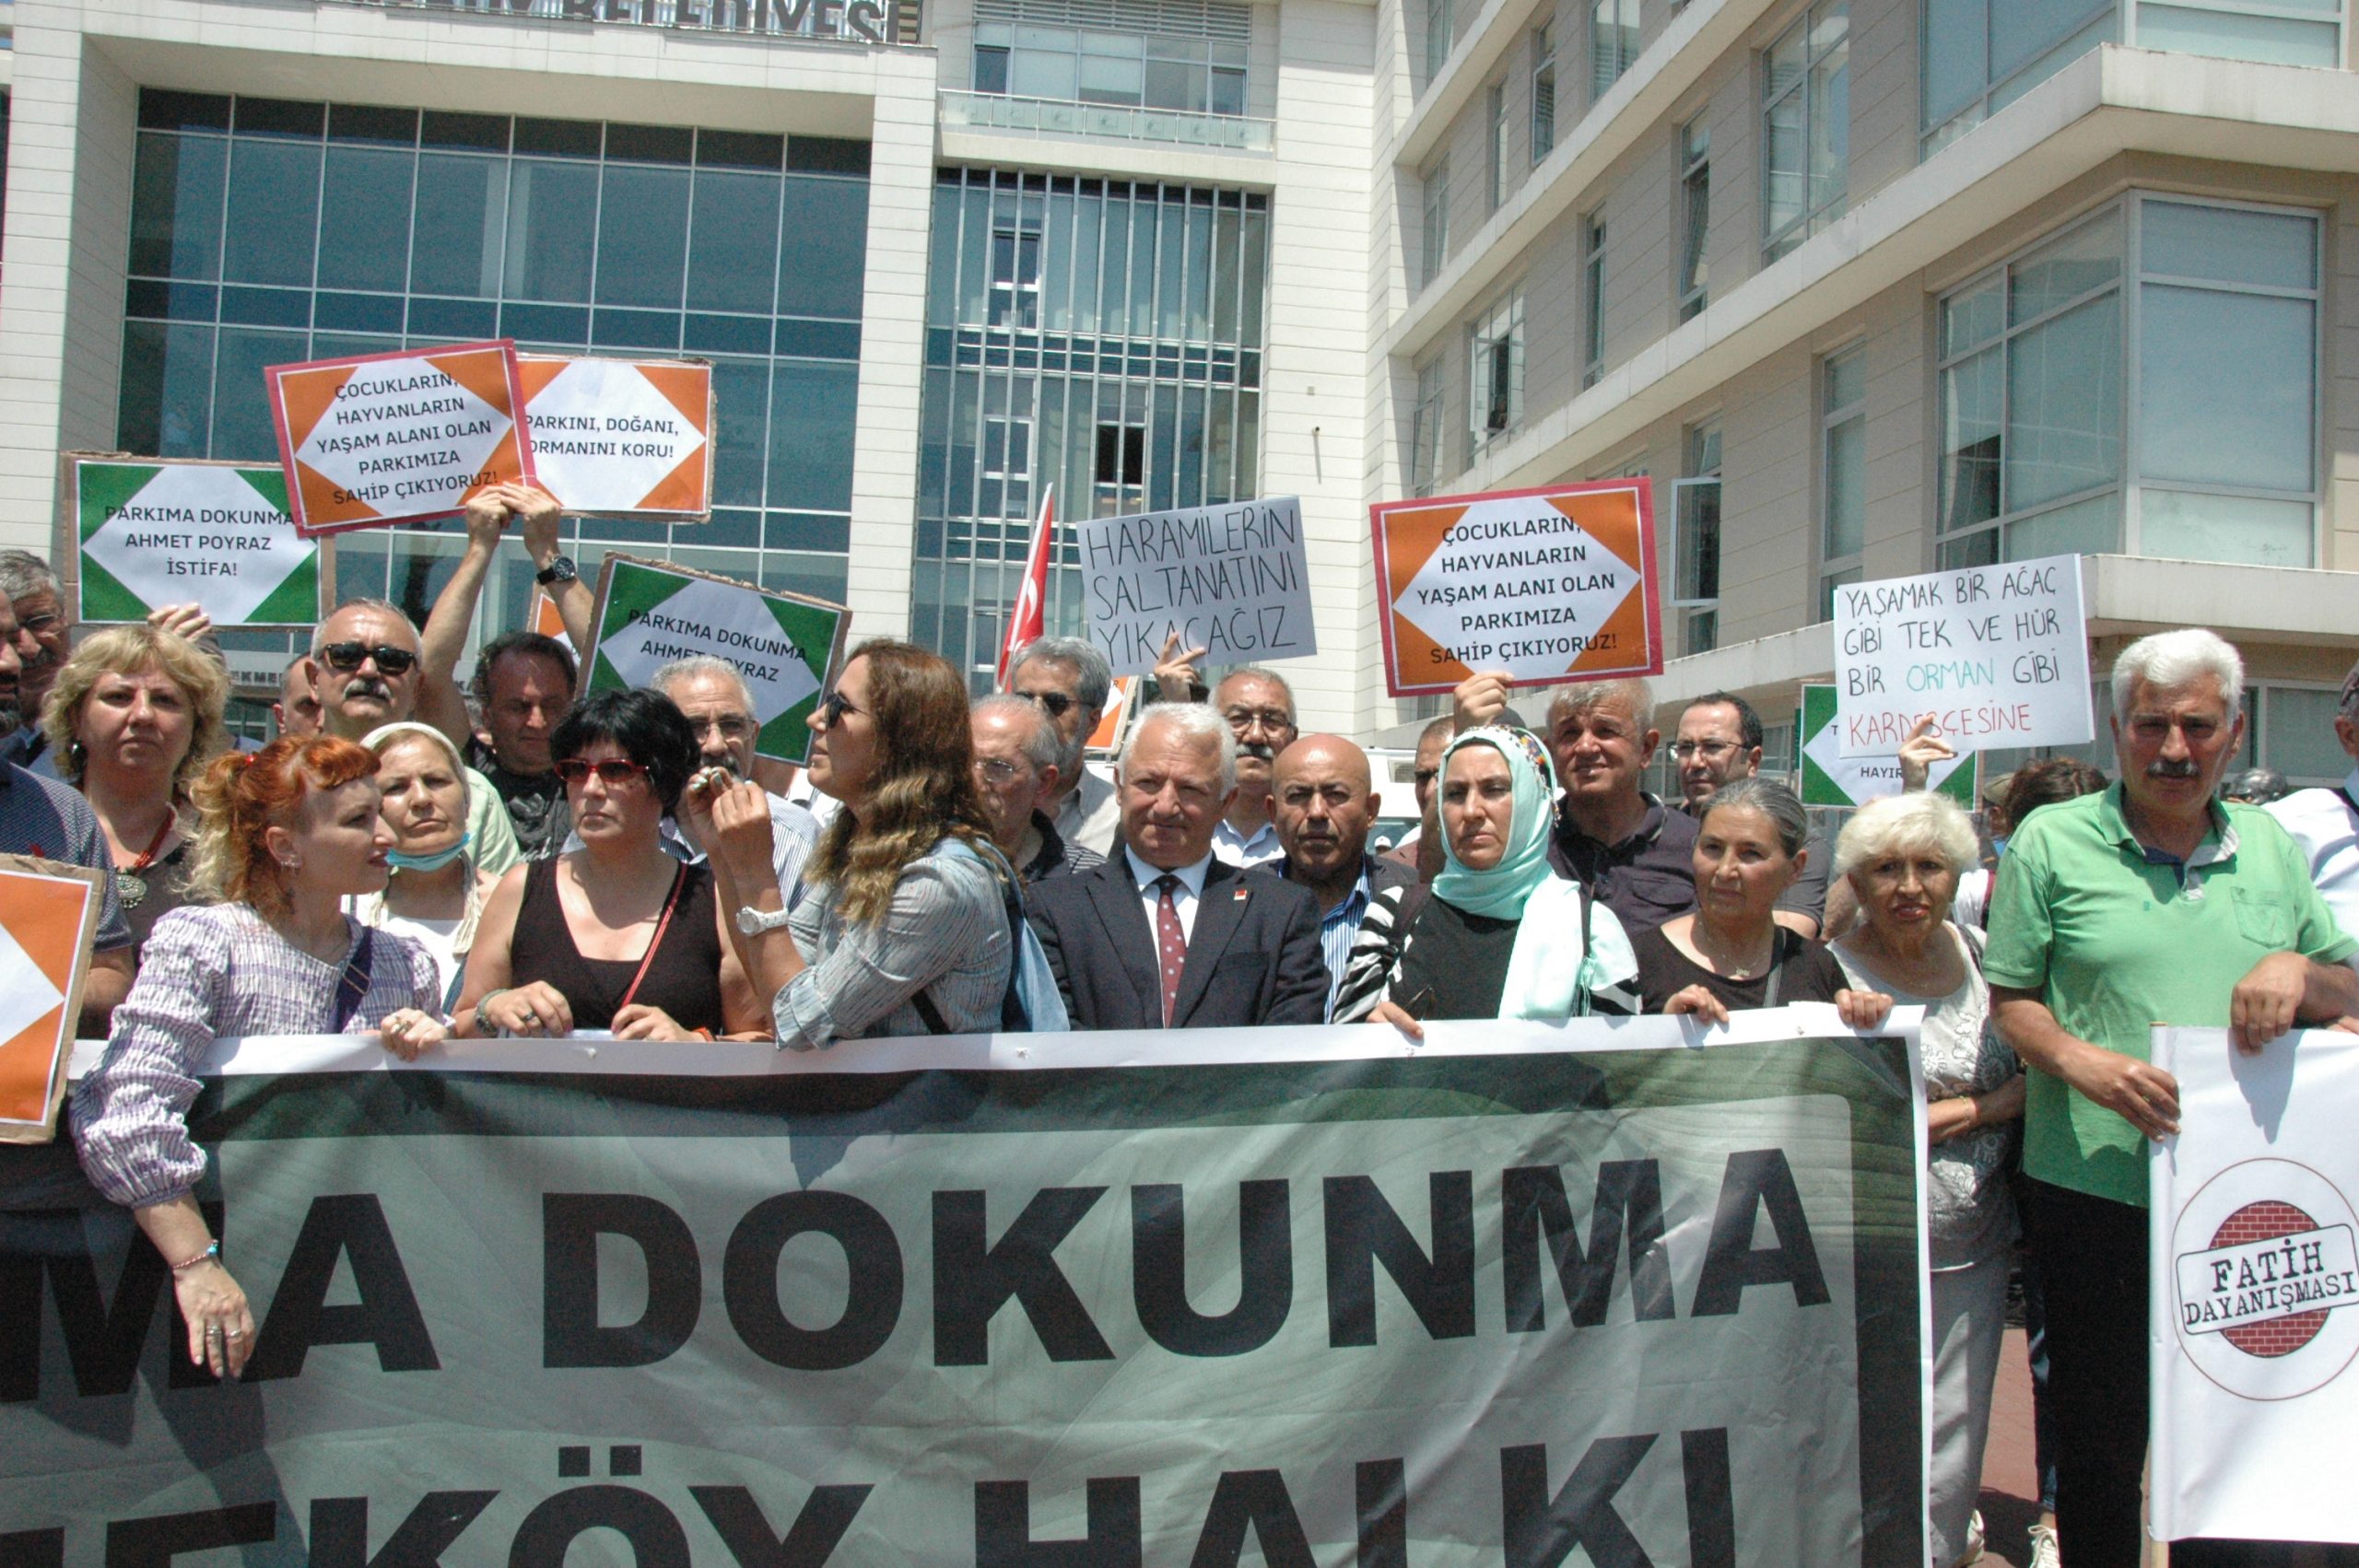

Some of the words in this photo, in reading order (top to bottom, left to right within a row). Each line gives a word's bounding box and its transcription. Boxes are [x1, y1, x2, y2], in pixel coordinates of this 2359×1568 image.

[334, 373, 458, 402] ÇOCUKLARIN,
[336, 397, 464, 425] HAYVANLARIN
[525, 415, 600, 432] PARKINI,
[606, 415, 679, 436] DOĞANI,
[317, 433, 381, 454] YAŞAM
[386, 425, 440, 447] ALANI
[445, 420, 492, 438] OLAN
[621, 443, 674, 458] KORU!
[358, 450, 461, 474] PARKIMIZA
[334, 485, 390, 505] SAHİP
[395, 471, 498, 499] ÇIKIYORUZ!
[105, 506, 194, 523] PARKIMA
[201, 509, 295, 525] DOKUNMA
[1442, 516, 1581, 545] ÇOCUKLARIN,
[125, 533, 193, 548] AHMET
[199, 535, 271, 550] POYRAZ
[1087, 507, 1295, 569] HARAMİLERİN
[167, 557, 238, 576] İSTİFA!
[1441, 545, 1585, 573] HAYVANLARIN
[1094, 552, 1297, 620] SALTANATINI
[1418, 585, 1486, 607] YAŞAM
[1494, 579, 1555, 599] ALANI
[1562, 573, 1614, 591] OLAN
[1846, 581, 1942, 618] YAŞAMAK
[1956, 571, 1989, 604] BİR
[2002, 567, 2056, 600] AĞAÇ
[1461, 607, 1576, 631] PARKIMIZA
[1844, 621, 1882, 656] GİBİ
[1898, 619, 1952, 649] TEK
[1968, 615, 2001, 642] VE
[2016, 609, 2060, 641] HÜR
[628, 610, 711, 640] PARKIMA
[717, 629, 806, 661] DOKUNMA
[1098, 605, 1296, 667] YIKACAĞIZ
[1431, 642, 1492, 663] SAHİP
[1499, 634, 1617, 661] ÇIKIYORUZ!
[711, 654, 780, 682] YRAZ
[1848, 665, 1885, 696] BİR
[1907, 658, 1993, 692] ORMAN
[2013, 649, 2060, 684] GİBİ
[542, 1148, 1831, 1370] DOKUNMA
[2211, 1238, 2324, 1293] FATİH
[2185, 1271, 2357, 1326] DAYANIŞMASI
